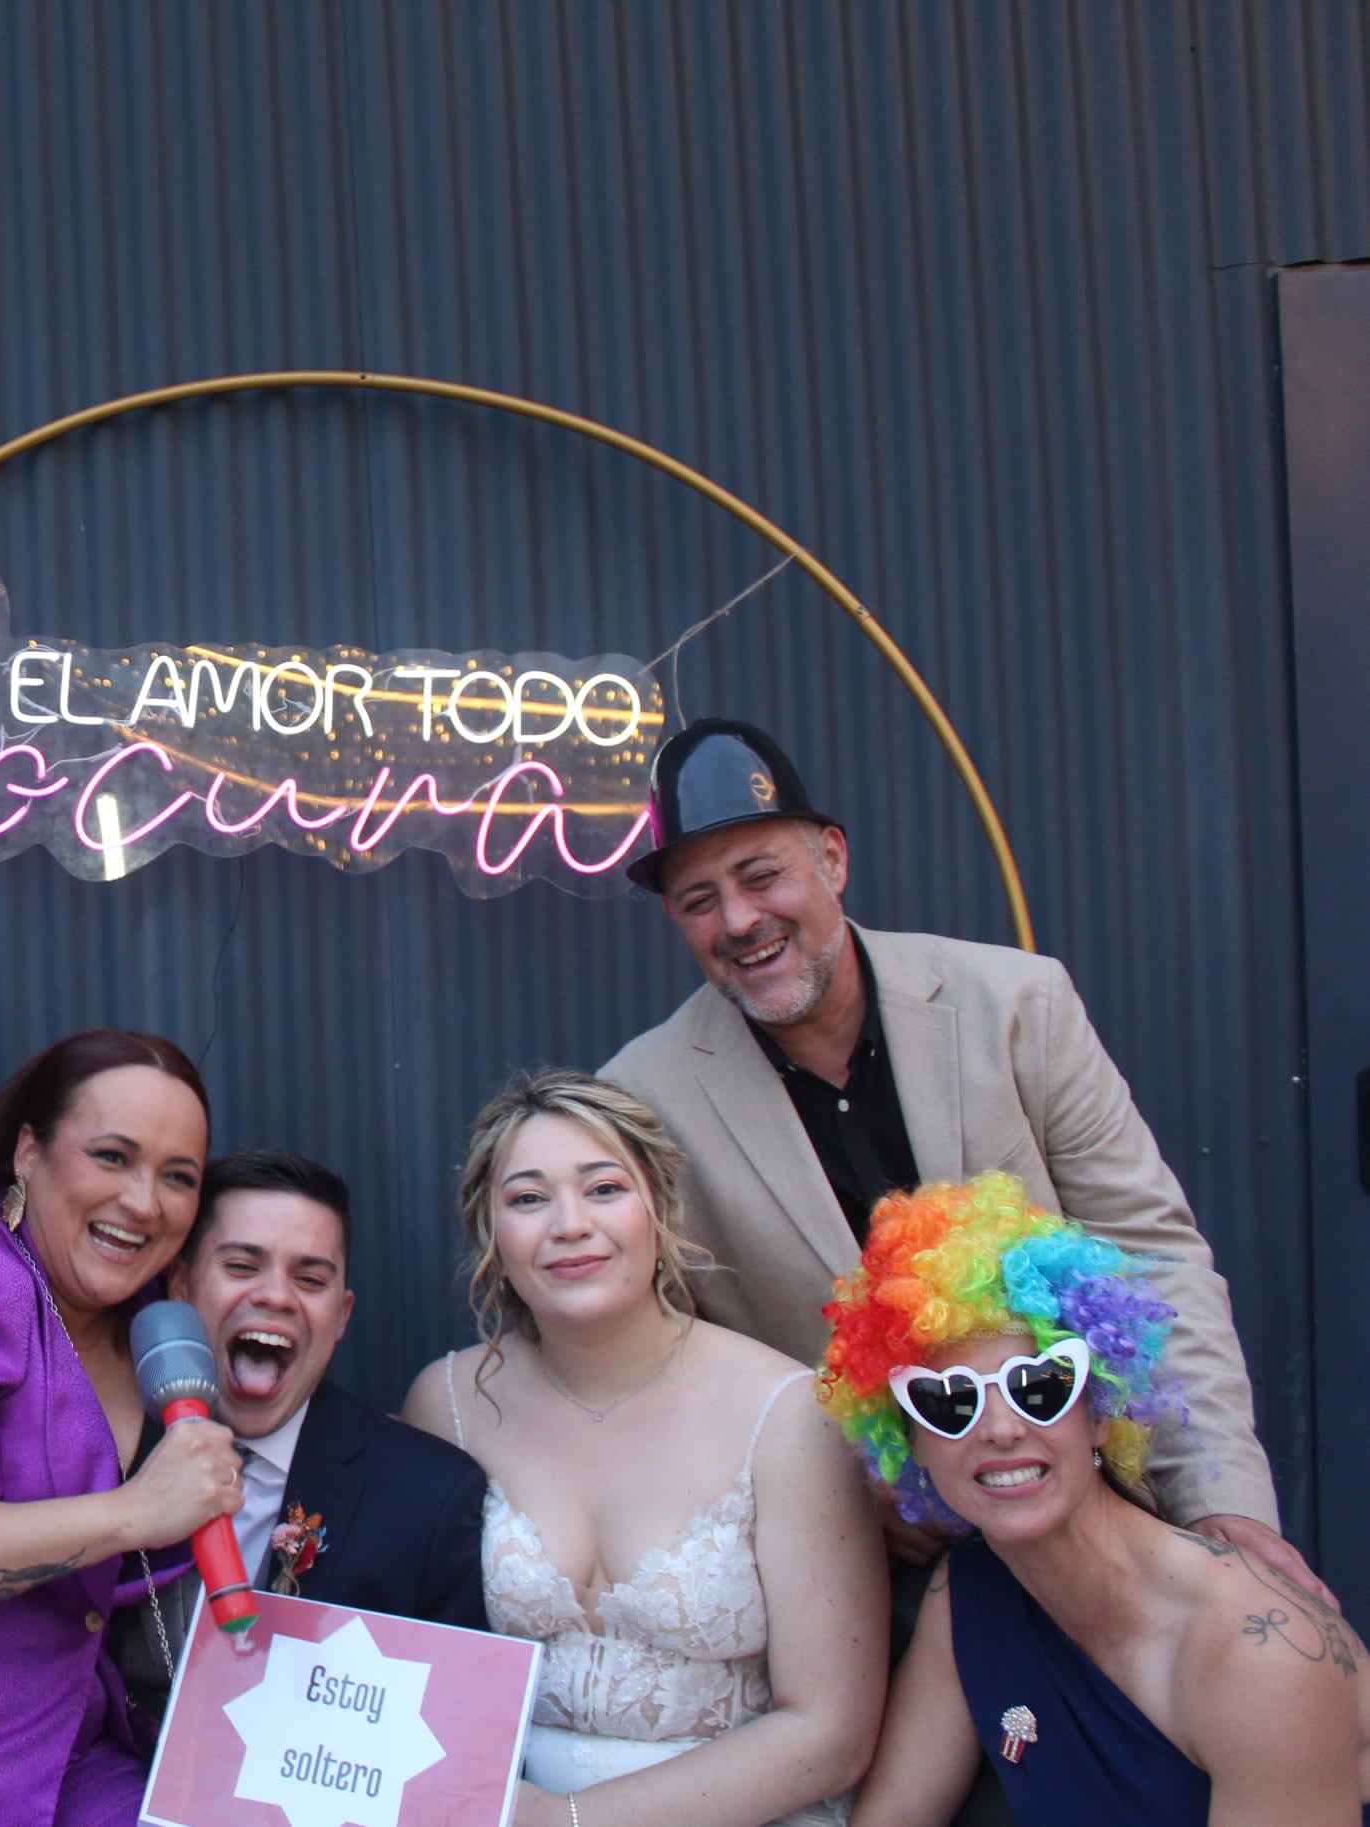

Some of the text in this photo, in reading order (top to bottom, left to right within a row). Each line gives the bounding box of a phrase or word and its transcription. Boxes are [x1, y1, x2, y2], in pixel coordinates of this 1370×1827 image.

[9, 650, 642, 747] EL AMOR TODO
[305, 1664, 387, 1725] Estoy
[279, 1744, 384, 1799] soltero
